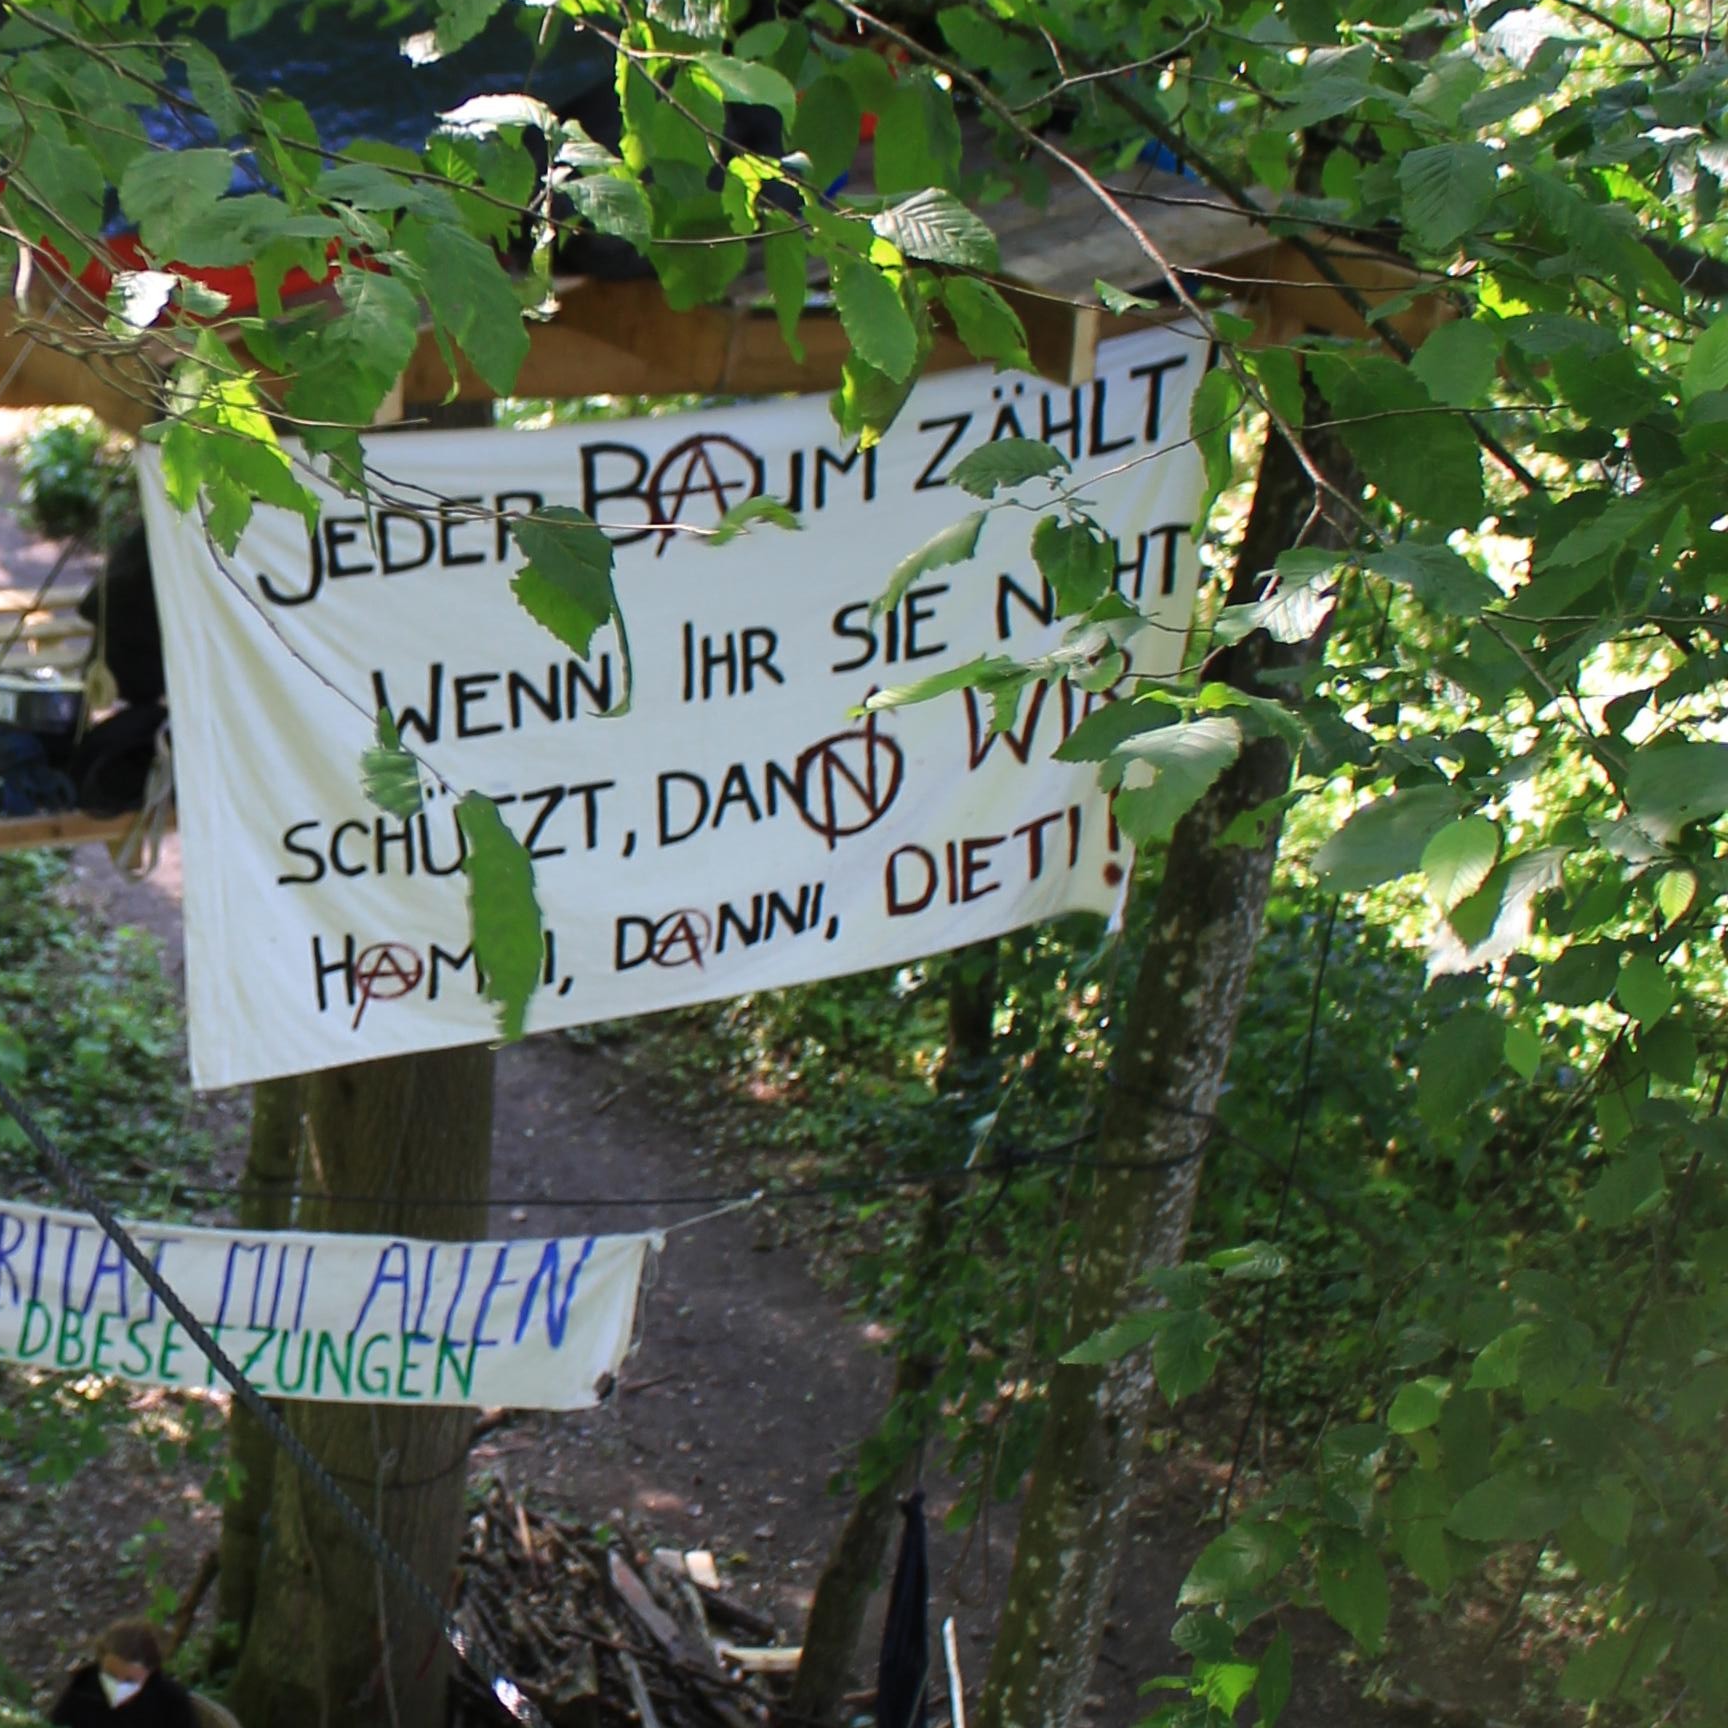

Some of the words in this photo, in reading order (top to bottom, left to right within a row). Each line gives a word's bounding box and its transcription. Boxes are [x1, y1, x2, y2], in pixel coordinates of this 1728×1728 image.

[252, 489, 544, 607] JEDER
[579, 432, 878, 558] BAUM
[370, 651, 614, 745] WENN
[681, 620, 785, 703] IHR
[830, 582, 951, 674] SIE
[995, 521, 1194, 642] NHT
[277, 779, 637, 886] SCHÜZT,
[656, 684, 905, 852] DANN
[311, 928, 575, 1032] HAMI,
